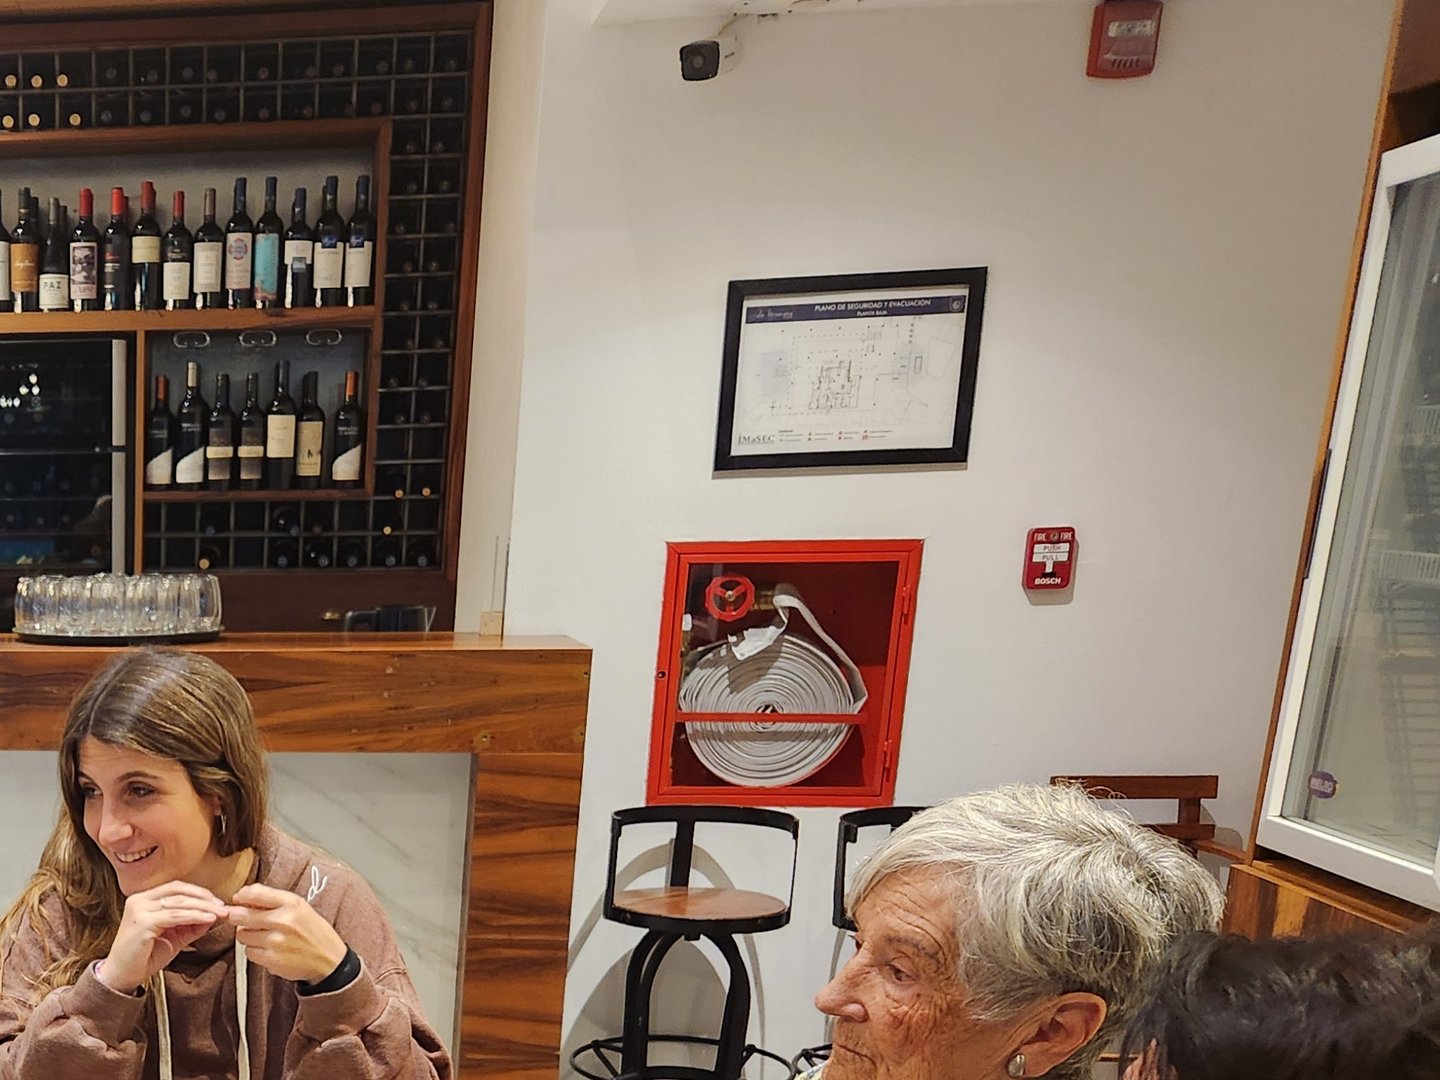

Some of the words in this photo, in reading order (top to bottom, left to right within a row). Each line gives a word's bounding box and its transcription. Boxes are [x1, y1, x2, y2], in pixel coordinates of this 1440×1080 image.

[44, 281, 61, 289] PAZ
[814, 304, 836, 312] PLANO
[837, 303, 846, 311] DE
[847, 301, 883, 311] SEGURIDAD
[889, 299, 931, 308] EVACUACIÓN
[1034, 532, 1047, 541] FIRE
[1060, 531, 1073, 540] FIRE
